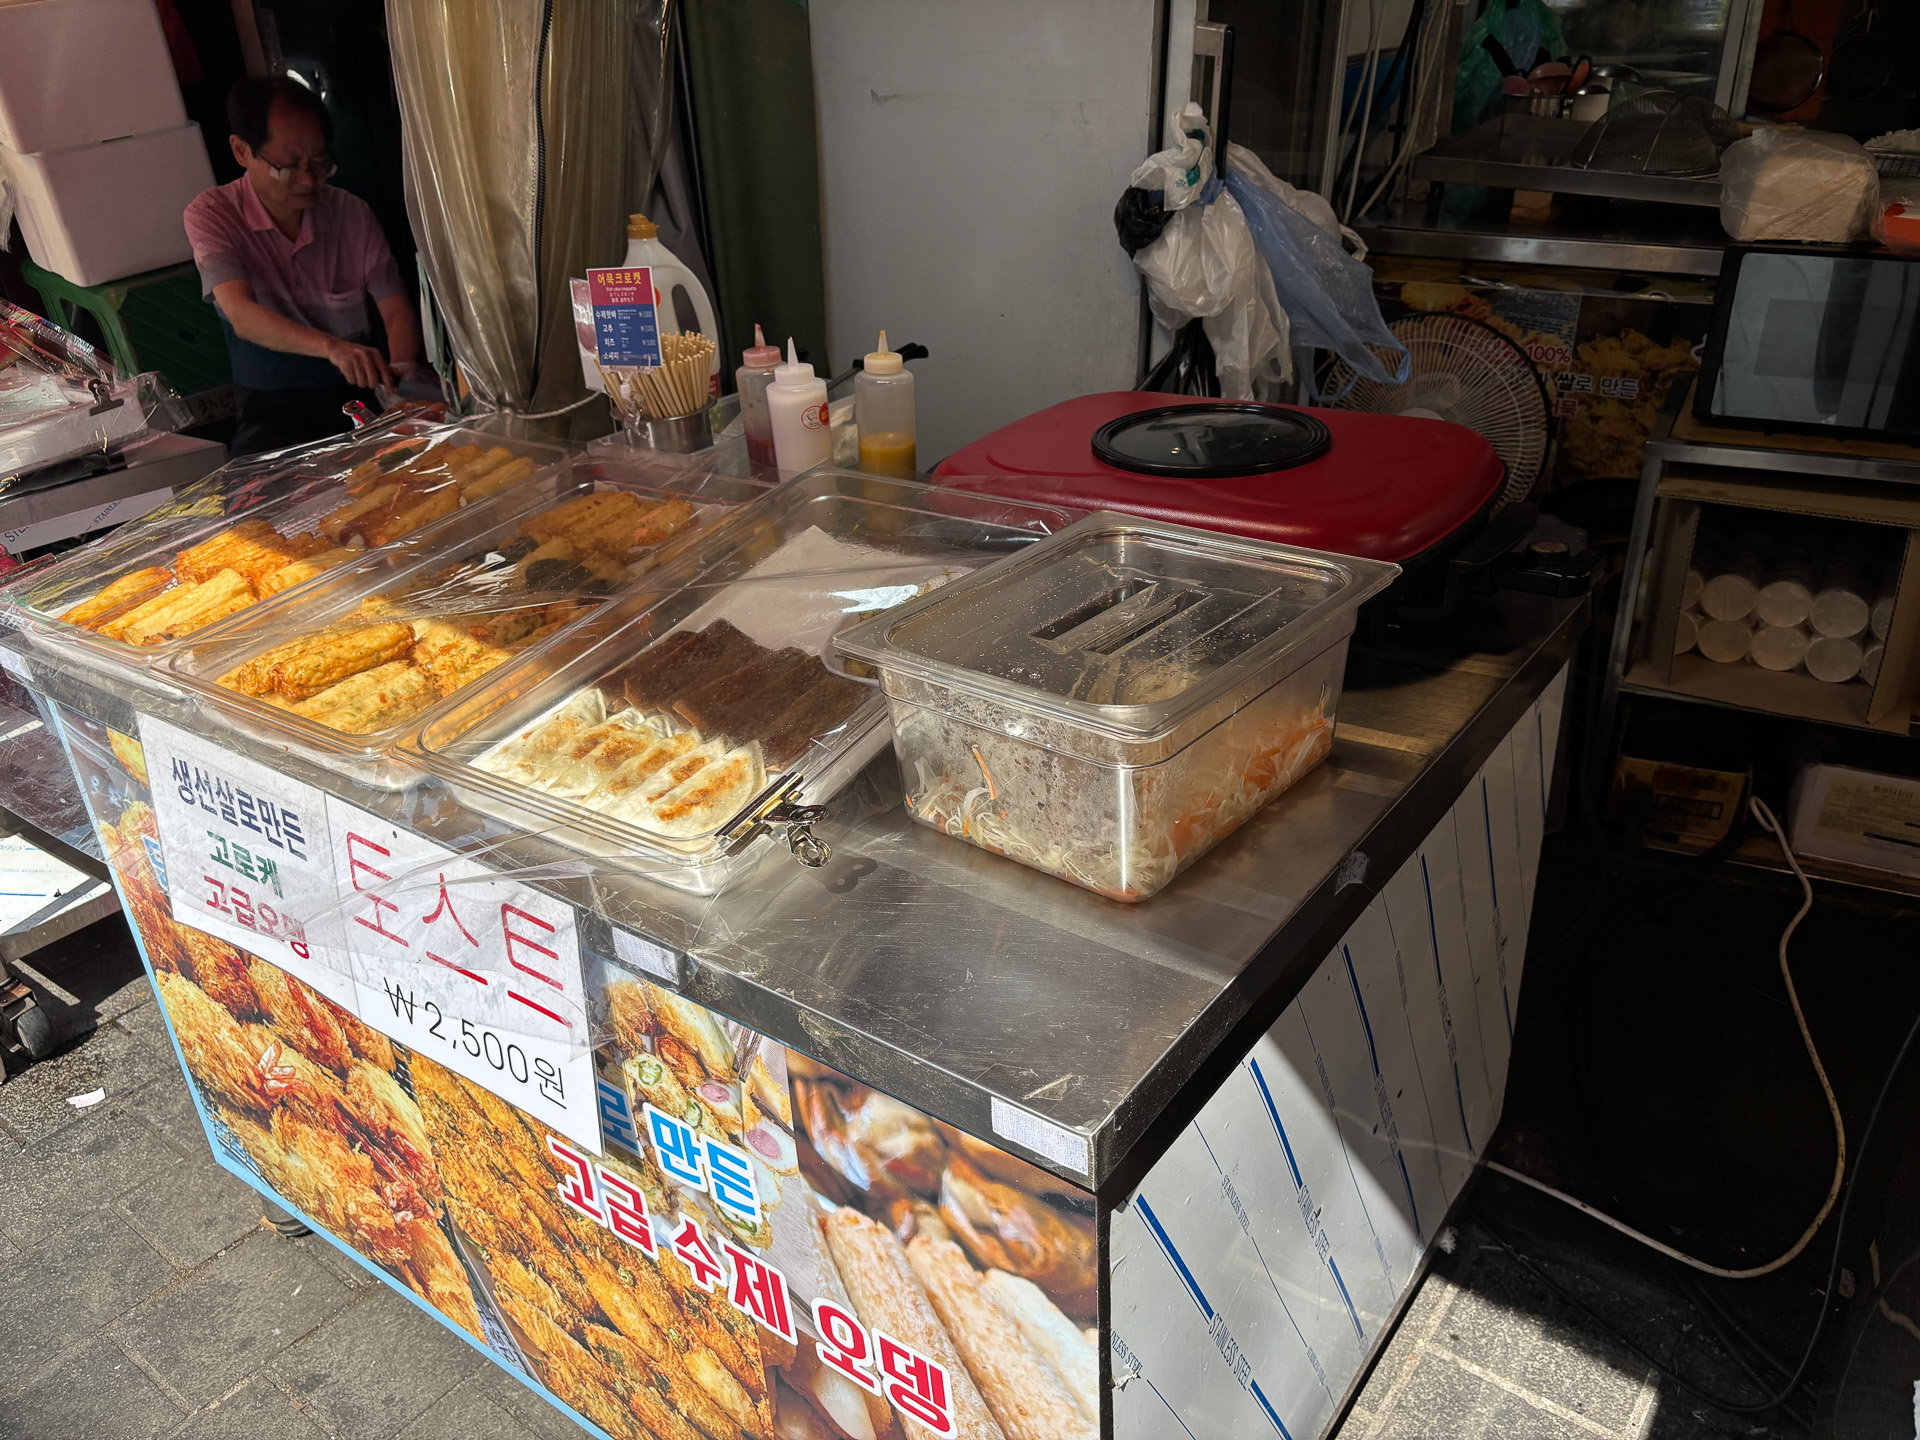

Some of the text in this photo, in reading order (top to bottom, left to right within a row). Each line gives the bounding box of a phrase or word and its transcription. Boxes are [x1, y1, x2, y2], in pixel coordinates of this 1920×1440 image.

[597, 272, 641, 286] 어묵크로켓
[602, 324, 613, 333] 고추
[1526, 345, 1571, 363] 100%
[1601, 378, 1638, 397] 만든
[172, 756, 308, 862] 생선살로만든
[206, 829, 285, 900] 고로케
[203, 874, 310, 960] 고급오뎅
[346, 831, 573, 1029] 토스트
[649, 1109, 756, 1217] 만든
[1221, 1174, 1251, 1236] STAINLESS STEEL
[1315, 1228, 1331, 1266] STEEL
[551, 1141, 951, 1433] 고급 수제 오뎅
[1208, 1312, 1252, 1391] STAINLESS STEEL
